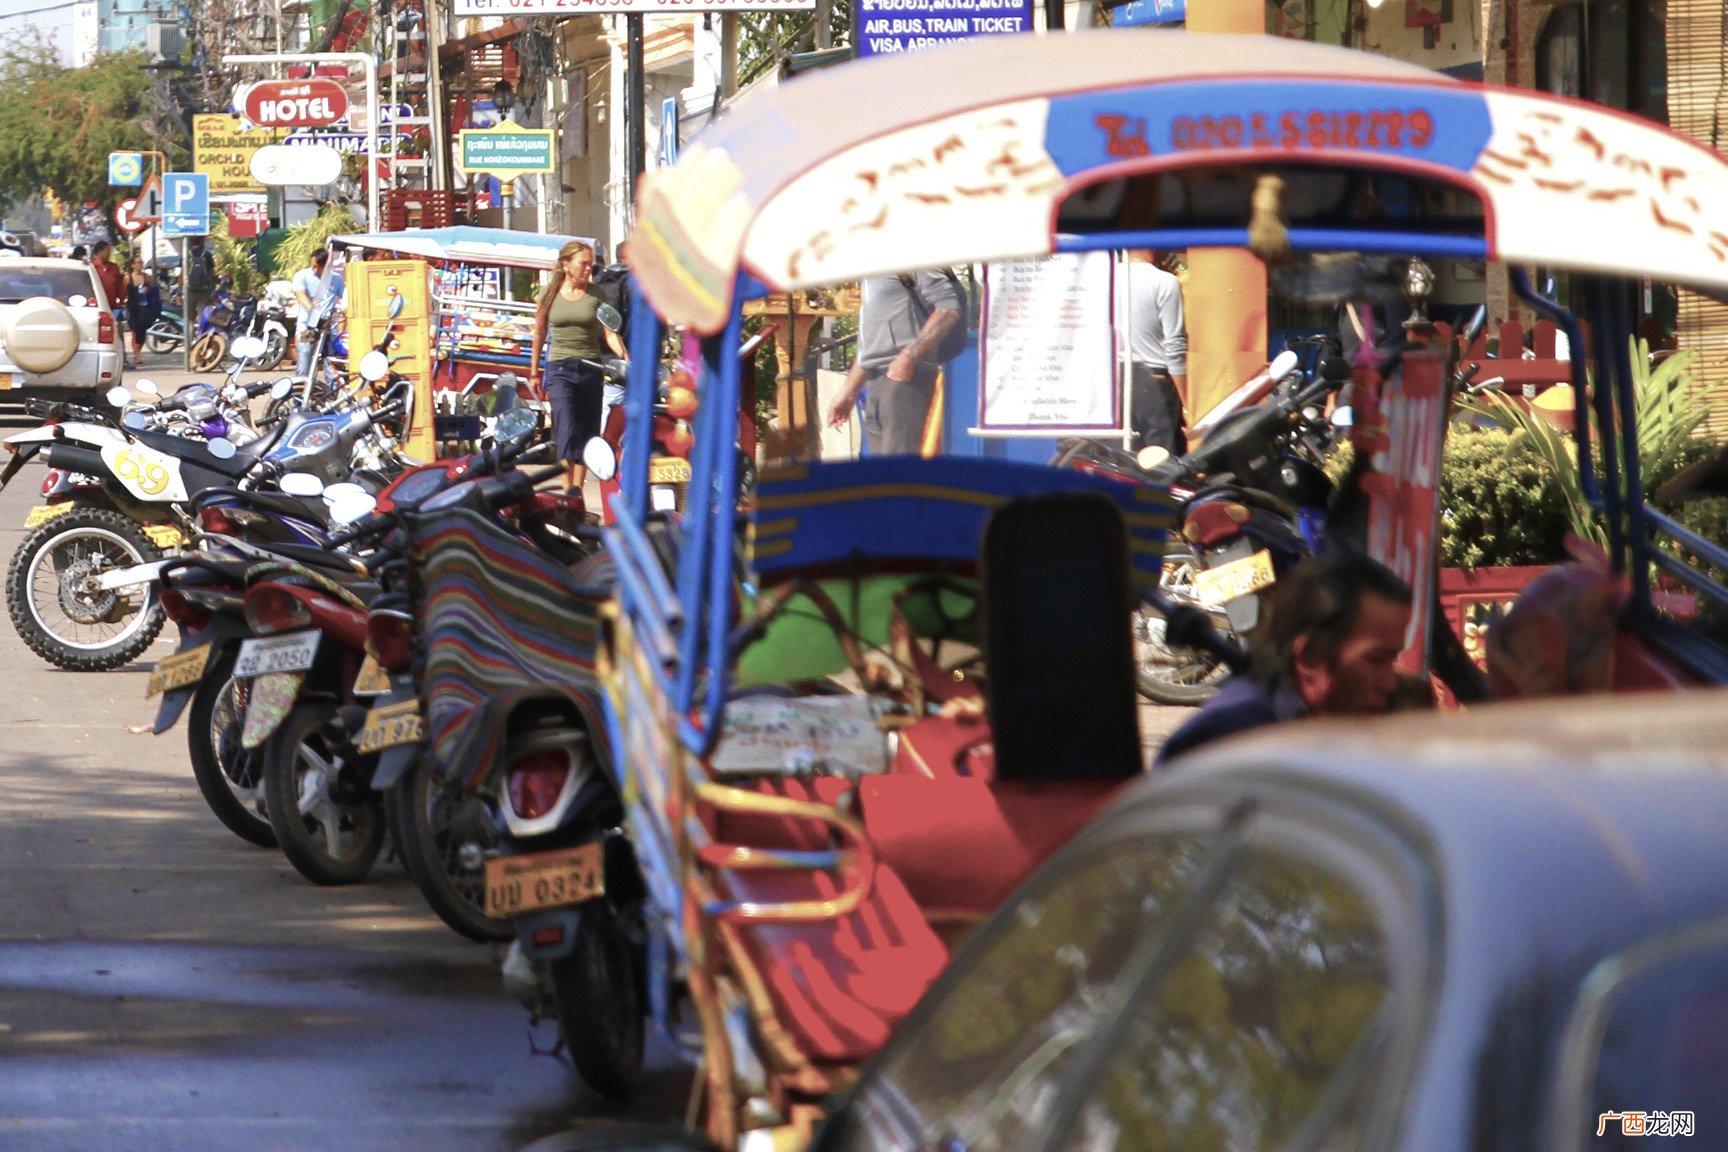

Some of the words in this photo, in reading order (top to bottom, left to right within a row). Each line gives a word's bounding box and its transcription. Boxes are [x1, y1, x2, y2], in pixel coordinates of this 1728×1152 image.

[865, 18, 968, 34] AIR,BUS,TRAIN
[973, 17, 1022, 32] TICKET
[869, 37, 903, 53] VISA
[260, 97, 334, 122] HOTEL
[198, 154, 244, 165] ORCHD
[175, 179, 196, 212] P
[114, 450, 169, 495] 69
[535, 868, 595, 905] 0324
